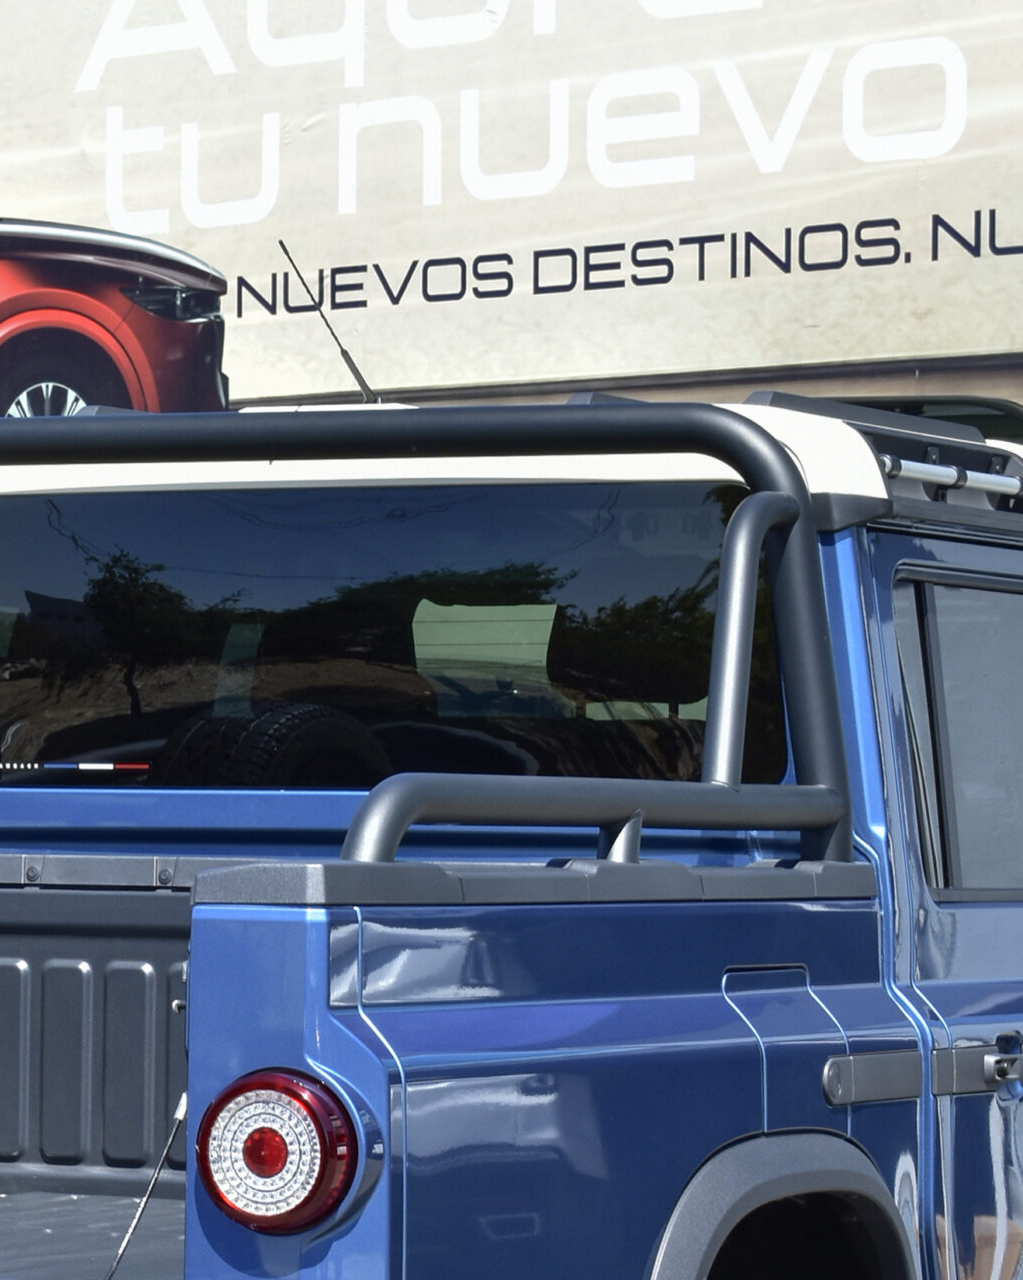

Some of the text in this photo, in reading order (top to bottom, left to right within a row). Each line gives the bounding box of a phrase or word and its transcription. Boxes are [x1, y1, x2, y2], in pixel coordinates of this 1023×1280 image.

[105, 106, 281, 236] tu
[338, 36, 968, 214] nuevo
[237, 253, 513, 319] NUEVOS
[532, 217, 912, 295] DESTINOS.
